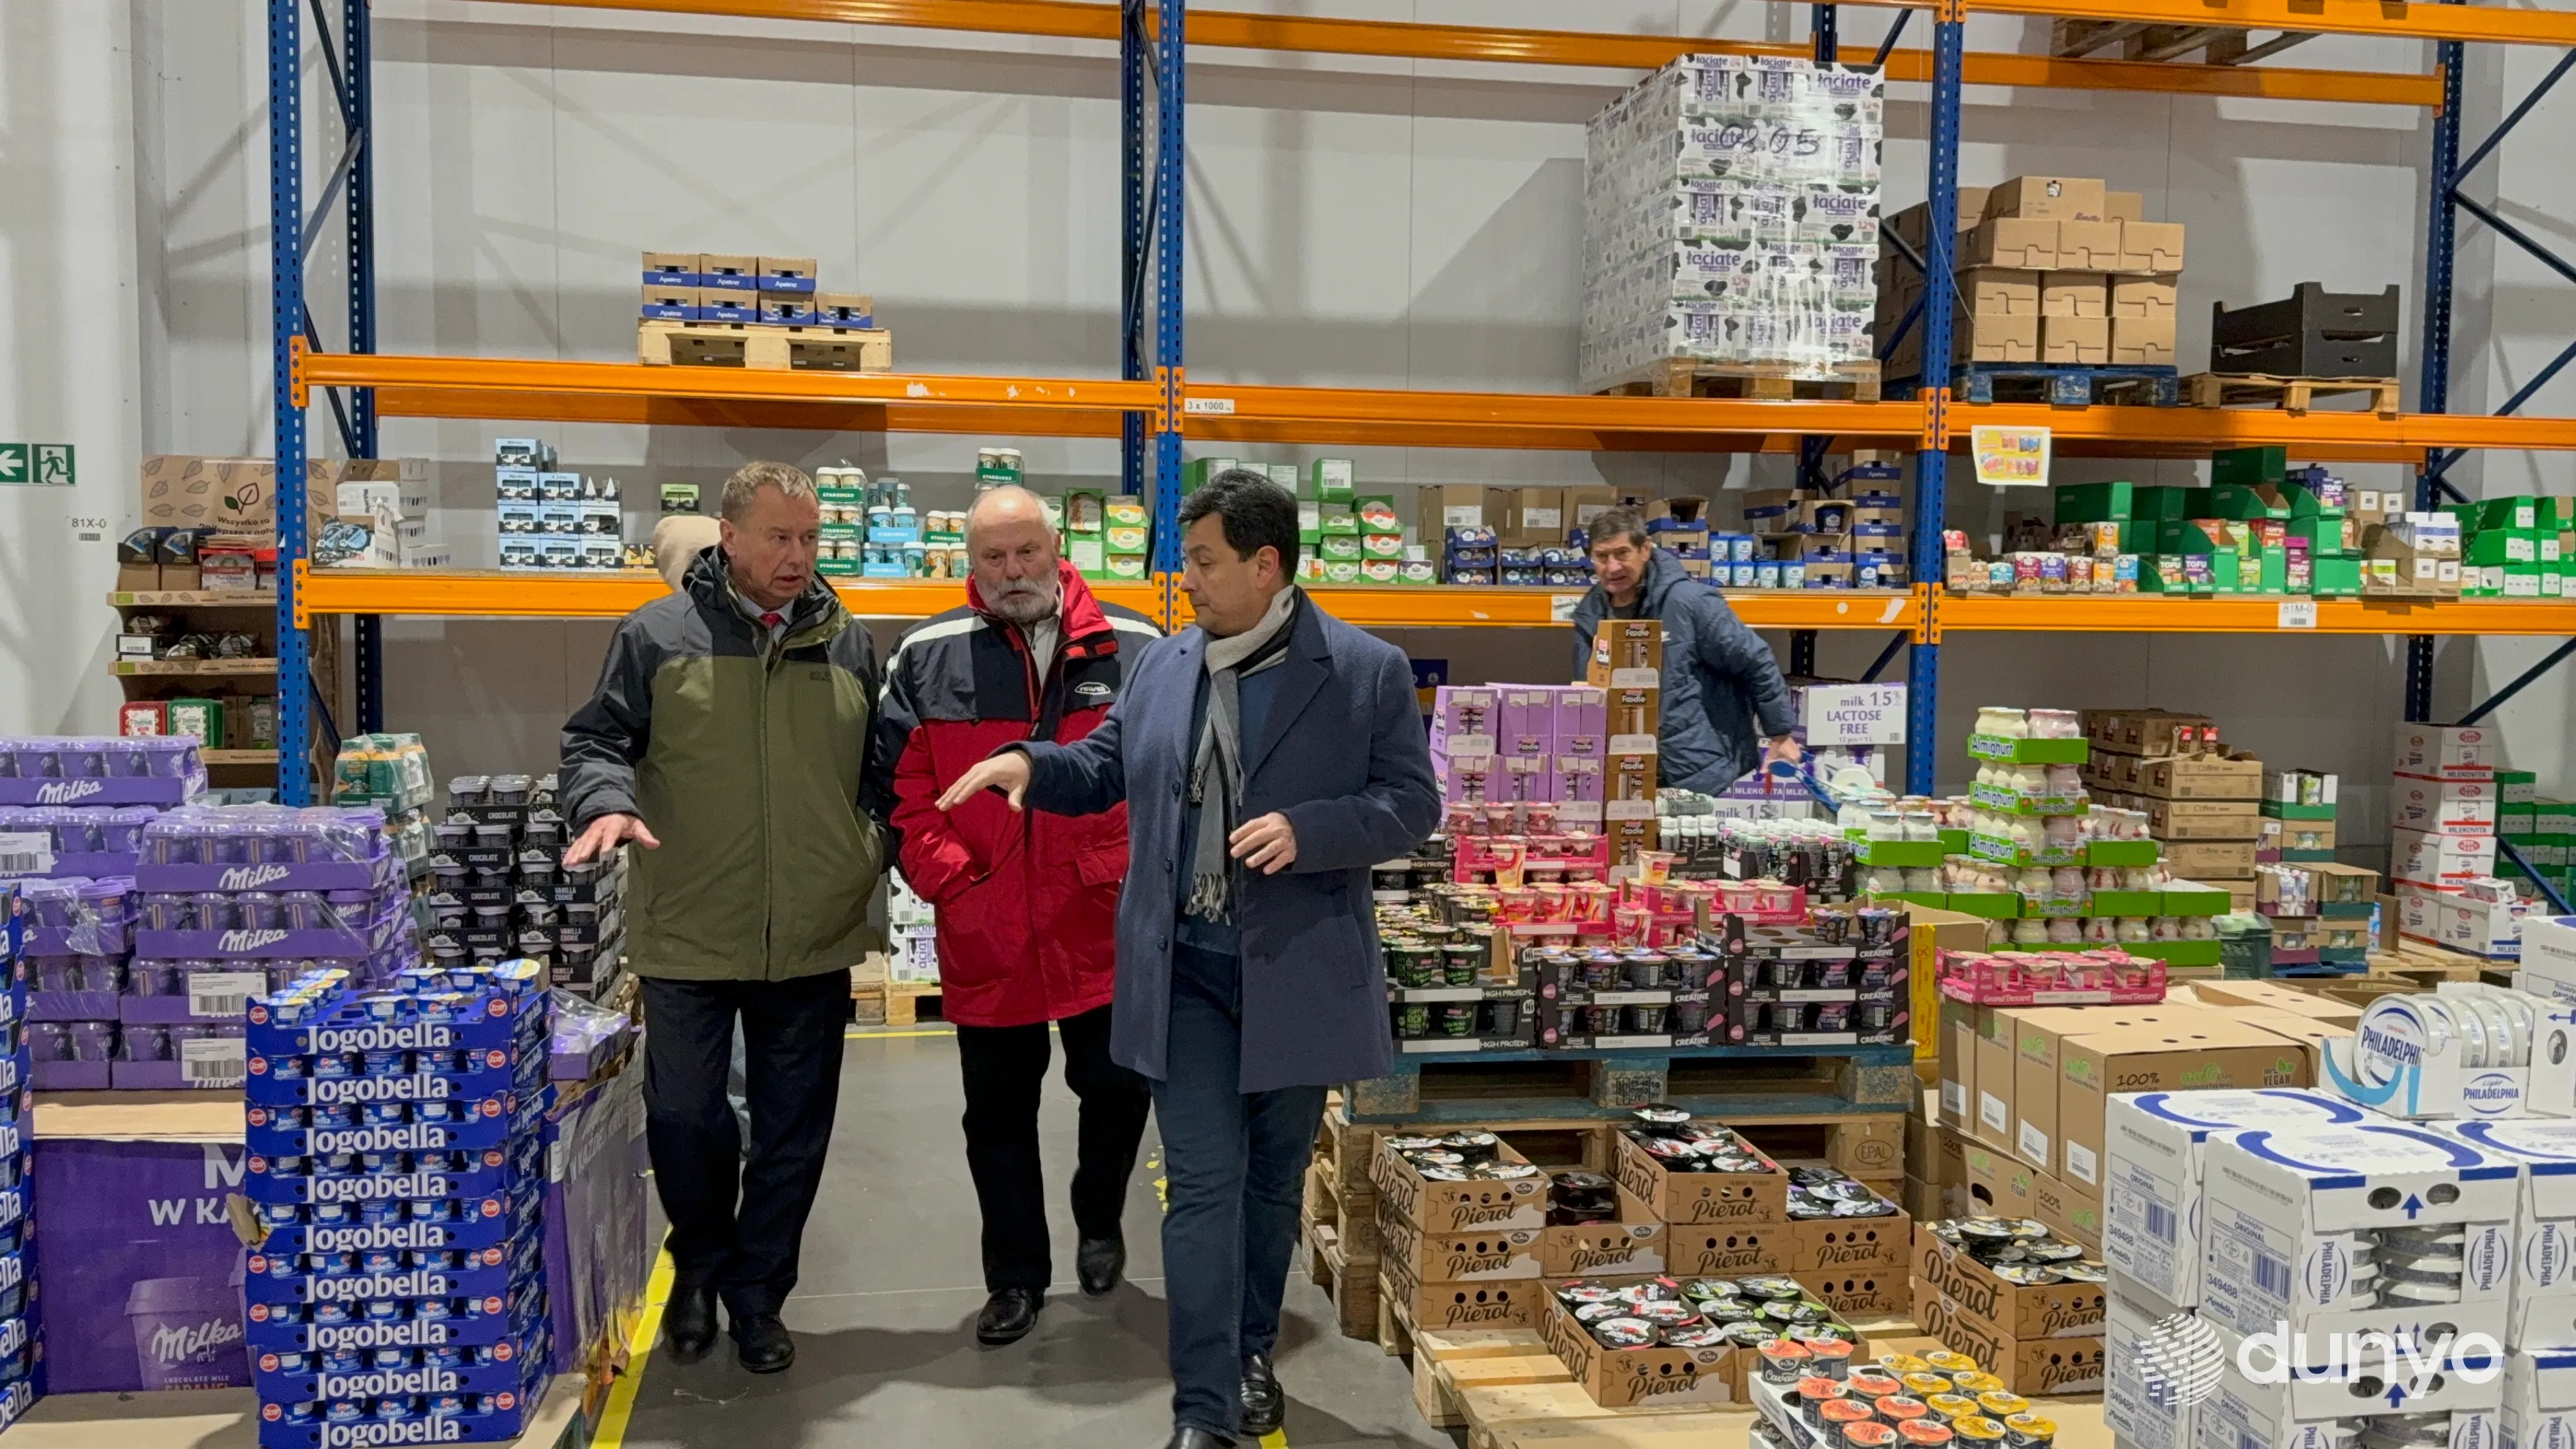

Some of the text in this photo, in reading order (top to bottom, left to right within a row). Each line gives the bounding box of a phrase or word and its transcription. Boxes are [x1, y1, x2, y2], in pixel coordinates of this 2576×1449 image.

[1813, 194, 1867, 210] łaciate
[1687, 251, 1741, 266] łaciate
[1188, 401, 1193, 410] 3
[1204, 401, 1224, 411] 1000
[1625, 629, 1650, 637] Foodie
[1622, 695, 1646, 703] Foodie
[1841, 696, 1865, 707] milk
[1827, 710, 1882, 722] LACTOSE
[1840, 723, 1868, 735] FREE
[1972, 738, 2014, 758] Almighurt
[1620, 762, 1644, 771] Foodie
[2447, 771, 2487, 779] MLEKOVITA
[37, 780, 103, 804] Milka
[1735, 787, 1783, 796] MLEKOTA
[1974, 786, 2015, 812] Almighurt
[488, 811, 517, 820] CHOCOLATE
[1715, 807, 1740, 818] milk
[2033, 804, 2076, 813] Almighurt
[1621, 827, 1644, 836] Foodie
[468, 853, 498, 862] CHOCOLATE
[1970, 836, 2013, 863] Almighurt
[2032, 855, 2074, 864] Almighurt
[220, 864, 291, 889] Milka
[471, 892, 501, 900] CHOCOLATE
[2039, 905, 2081, 915] Almighurt
[219, 929, 288, 951] Milka
[468, 934, 497, 942] CHOCOLATE
[1860, 948, 1894, 958] CREATINE
[1502, 989, 1531, 997] PROTEIN
[1675, 993, 1710, 1003] CREATINE
[1860, 991, 1894, 1000] CREATINE
[308, 1025, 450, 1054] Jogobella
[1500, 1039, 1529, 1047] PROTEIN
[1675, 1037, 1710, 1047] CREATINE
[1860, 1033, 1895, 1044] CREATINE
[2362, 1025, 2422, 1066] PHILADELPHI
[307, 1074, 448, 1105] Jogobella
[2116, 1073, 2160, 1087] 100%
[2264, 1074, 2291, 1086] VEGAN
[2463, 1087, 2520, 1101] PHILADELPHIA
[307, 1123, 445, 1156] Jogobella
[1861, 1147, 1888, 1161] EPAL
[307, 1172, 446, 1202] Jogobella
[1375, 1153, 1419, 1216] Pierot
[1612, 1145, 1659, 1207] Pierot
[2130, 1174, 2155, 1193] ORIGINAL
[148, 1199, 186, 1226] W
[1451, 1201, 1520, 1230] Pierot
[1692, 1197, 1760, 1222] Pierot
[305, 1222, 443, 1252] Jogobella
[2108, 1223, 2135, 1247] 349488
[2234, 1221, 2266, 1243] ORIGINAL
[1447, 1251, 1516, 1279] Pierot
[1570, 1245, 1638, 1272] Pierot
[1697, 1246, 1764, 1274] Pierot
[1816, 1241, 1884, 1268] Pierot
[2480, 1227, 2496, 1292] PHILADELPHIA
[2539, 1224, 2555, 1288] PHILADELPHIA
[2319, 1240, 2334, 1306] PHILADELPHIA
[306, 1271, 446, 1303] Jogobella
[1924, 1248, 2004, 1322] Pierot
[2206, 1273, 2239, 1300] 349488
[1446, 1301, 1516, 1328] Pierot
[152, 1317, 242, 1363] Milka
[306, 1319, 446, 1351] Jogobella
[1543, 1308, 1595, 1385] Pierot
[1924, 1300, 2004, 1374] Pierot
[317, 1368, 457, 1401] Jogobella
[1628, 1371, 1704, 1401] Pierot
[2220, 1399, 2250, 1425] ORIGINAL
[321, 1415, 460, 1448] Jogobella
